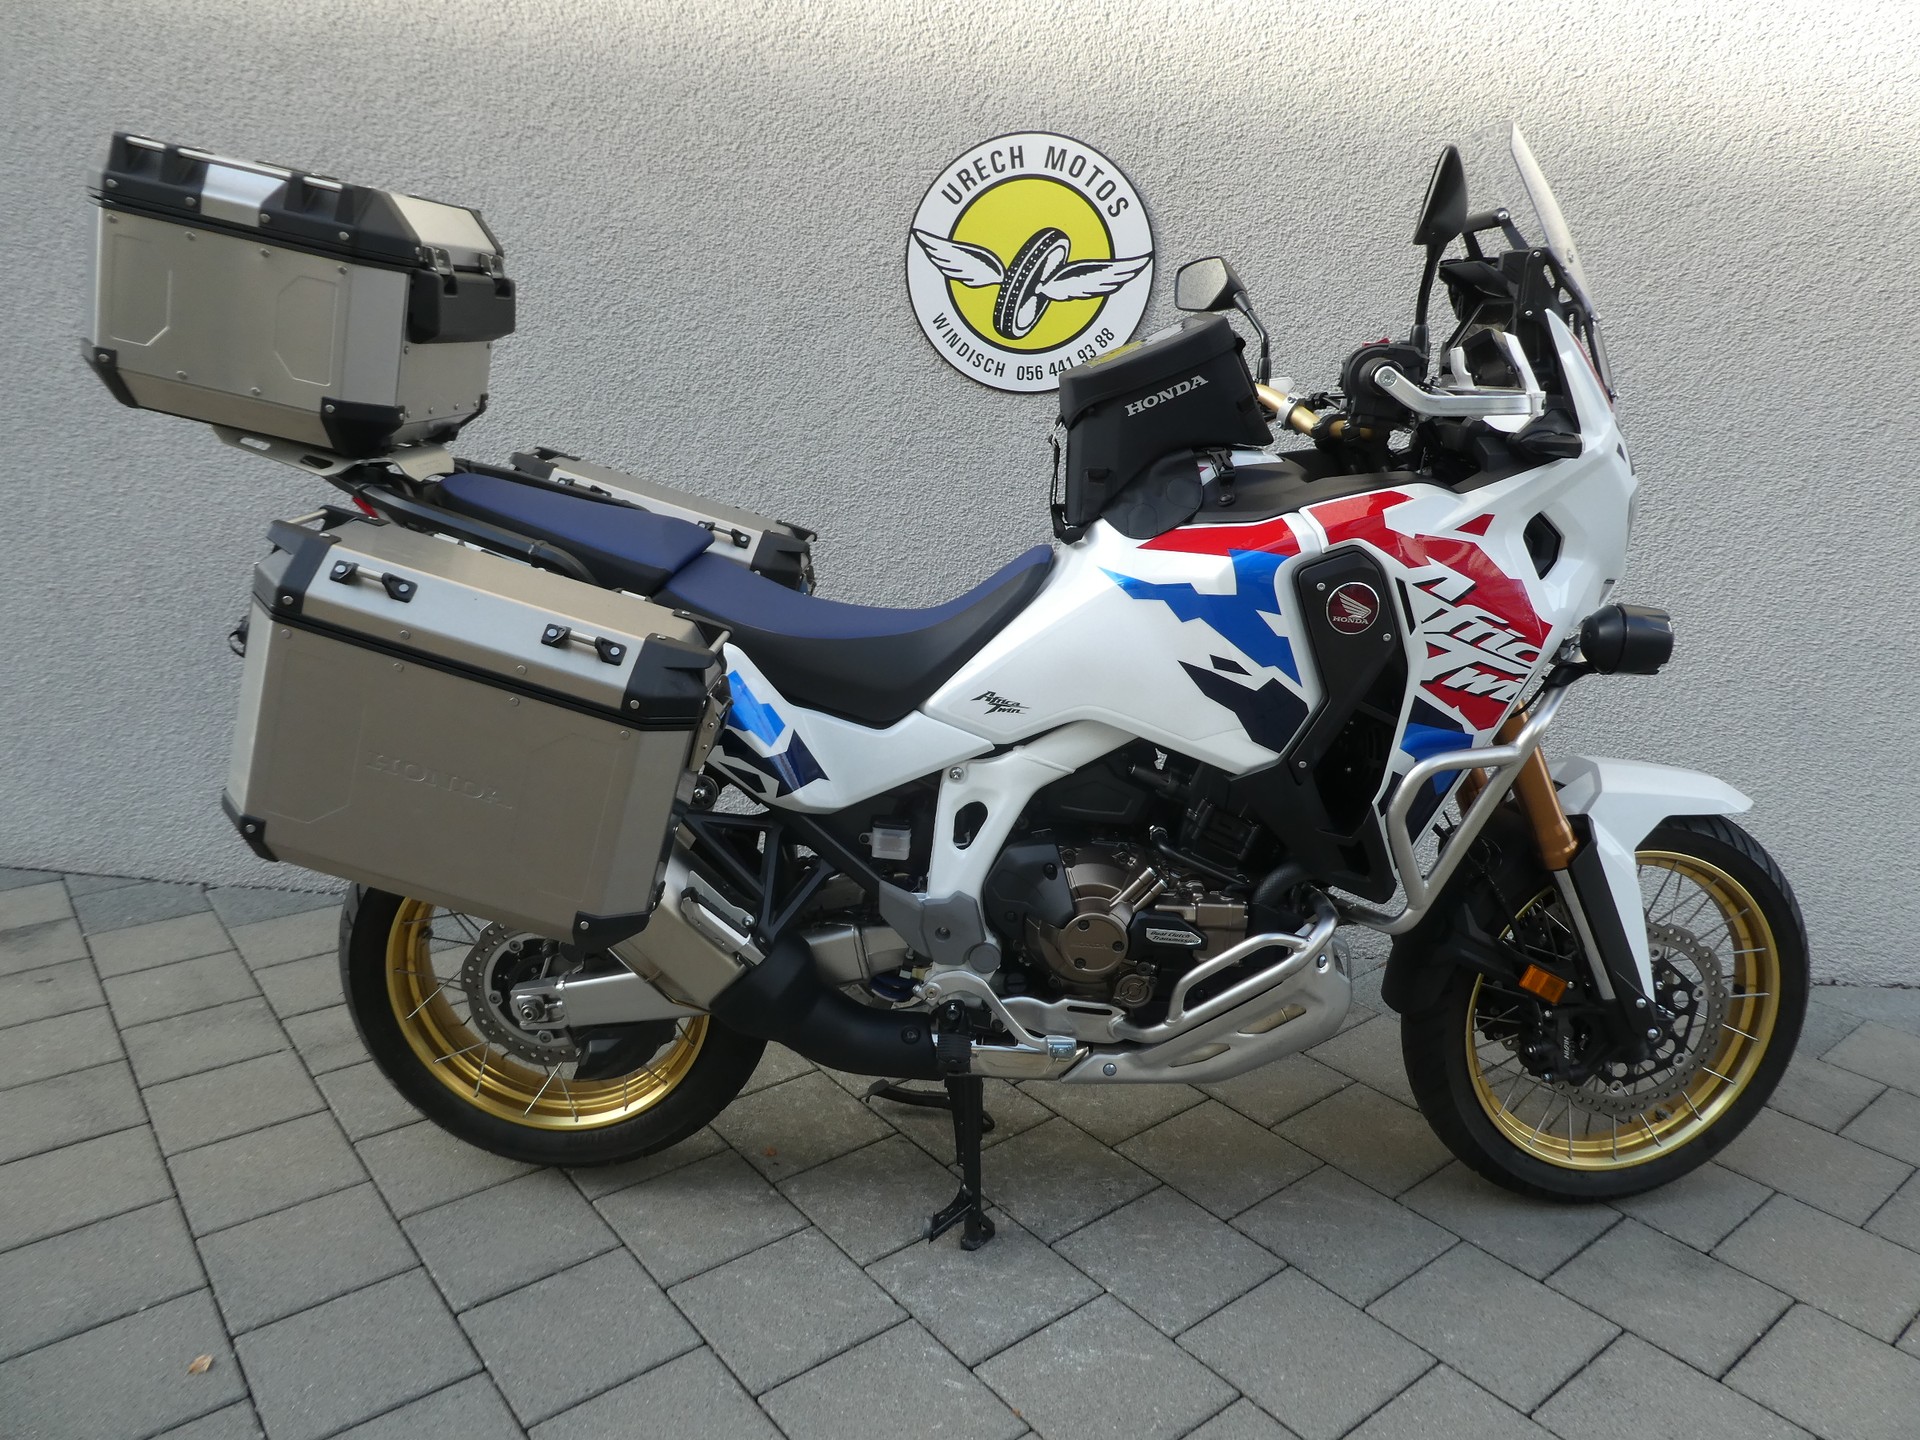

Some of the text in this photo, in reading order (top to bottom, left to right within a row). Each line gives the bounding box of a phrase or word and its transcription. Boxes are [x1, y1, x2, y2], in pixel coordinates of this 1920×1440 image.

[940, 145, 1130, 218] URECH MOTOS
[931, 311, 1116, 381] WINDISCH 056 441 93 88
[1124, 374, 1209, 417] HONDA
[1331, 615, 1370, 625] HONDA
[1405, 556, 1542, 669] Afric
[970, 690, 1022, 707] Africa
[366, 750, 513, 811] HONDA
[1167, 931, 1190, 939] Clutch
